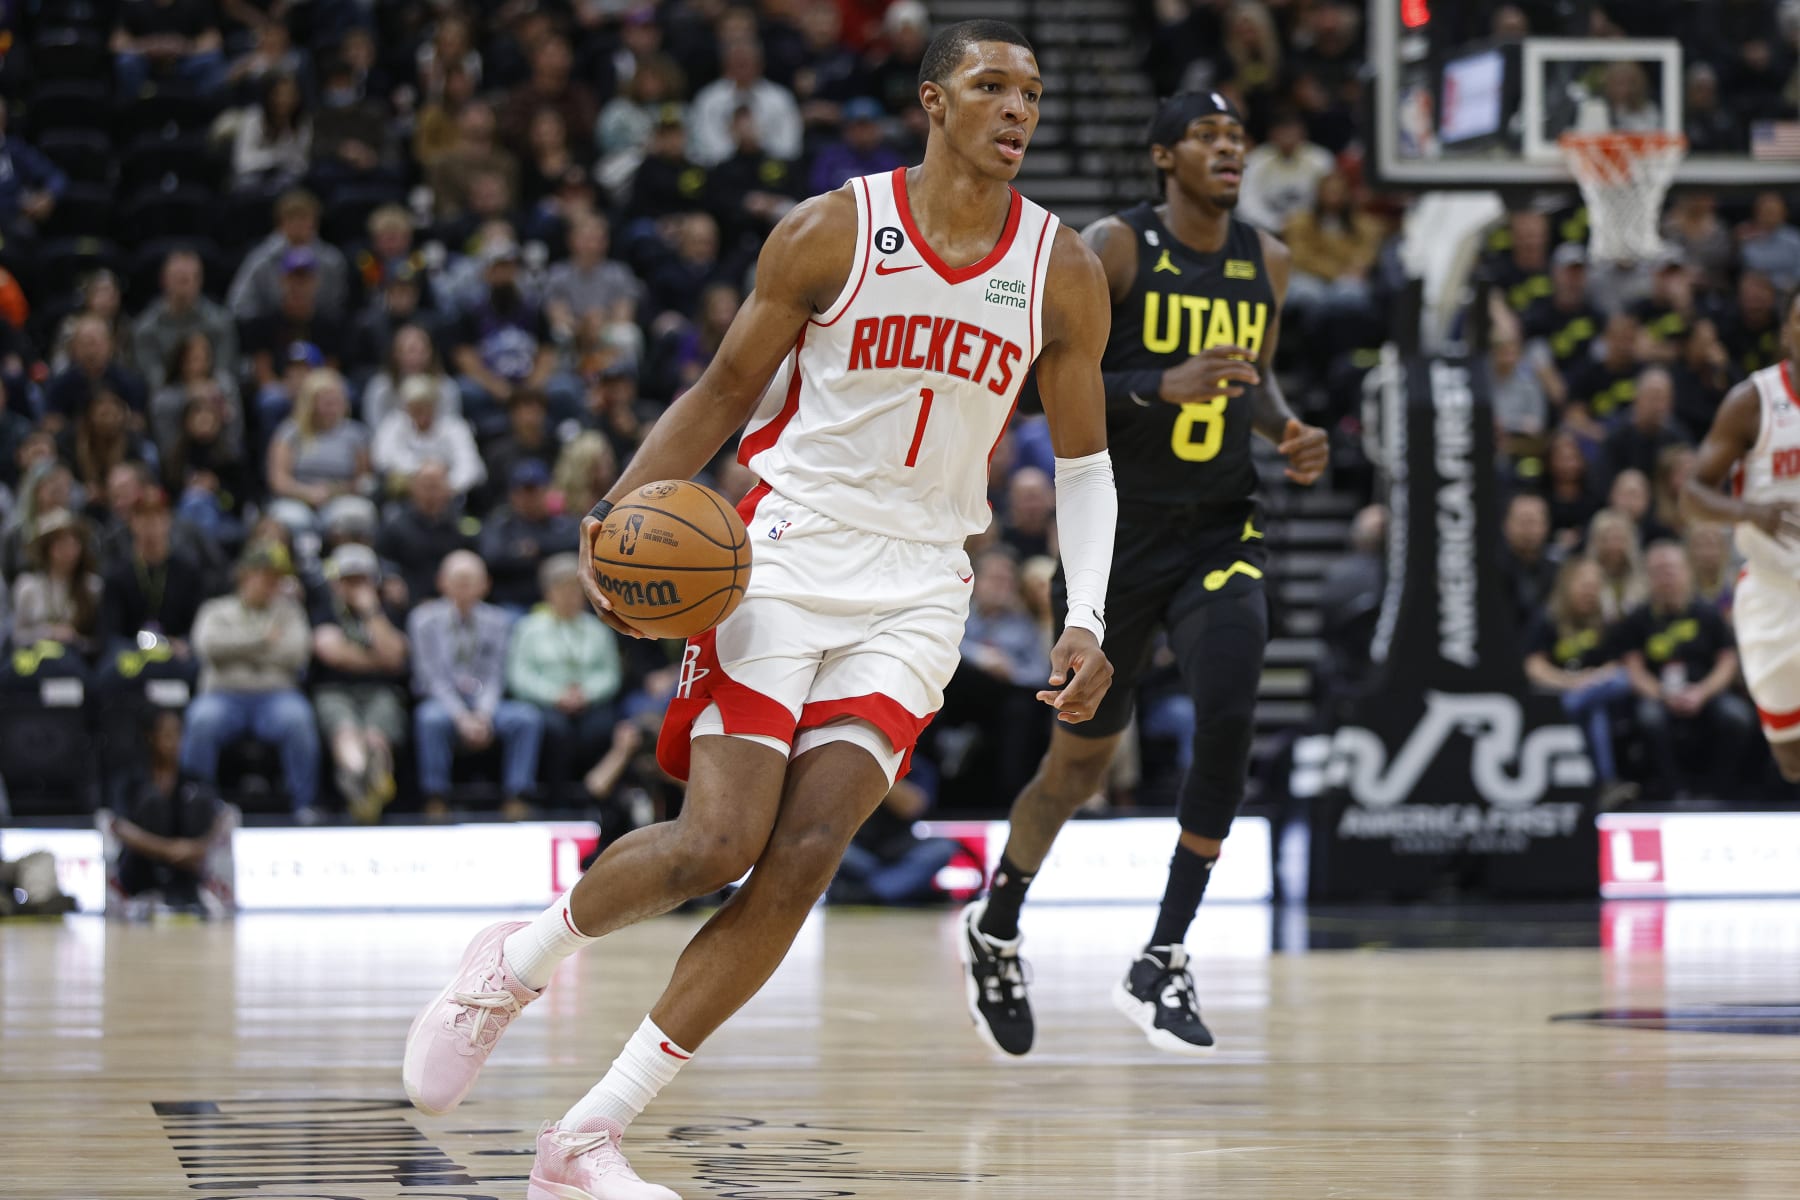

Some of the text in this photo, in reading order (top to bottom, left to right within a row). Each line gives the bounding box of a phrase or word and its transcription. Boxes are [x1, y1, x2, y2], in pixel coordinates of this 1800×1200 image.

[881, 230, 898, 251] 6
[985, 288, 1026, 309] karma
[989, 278, 1026, 295] credit
[1142, 290, 1267, 362] UTAH
[847, 314, 1023, 397] ROCKETS
[904, 387, 934, 468] 1
[1171, 379, 1228, 462] 8
[595, 566, 681, 606] Wilson
